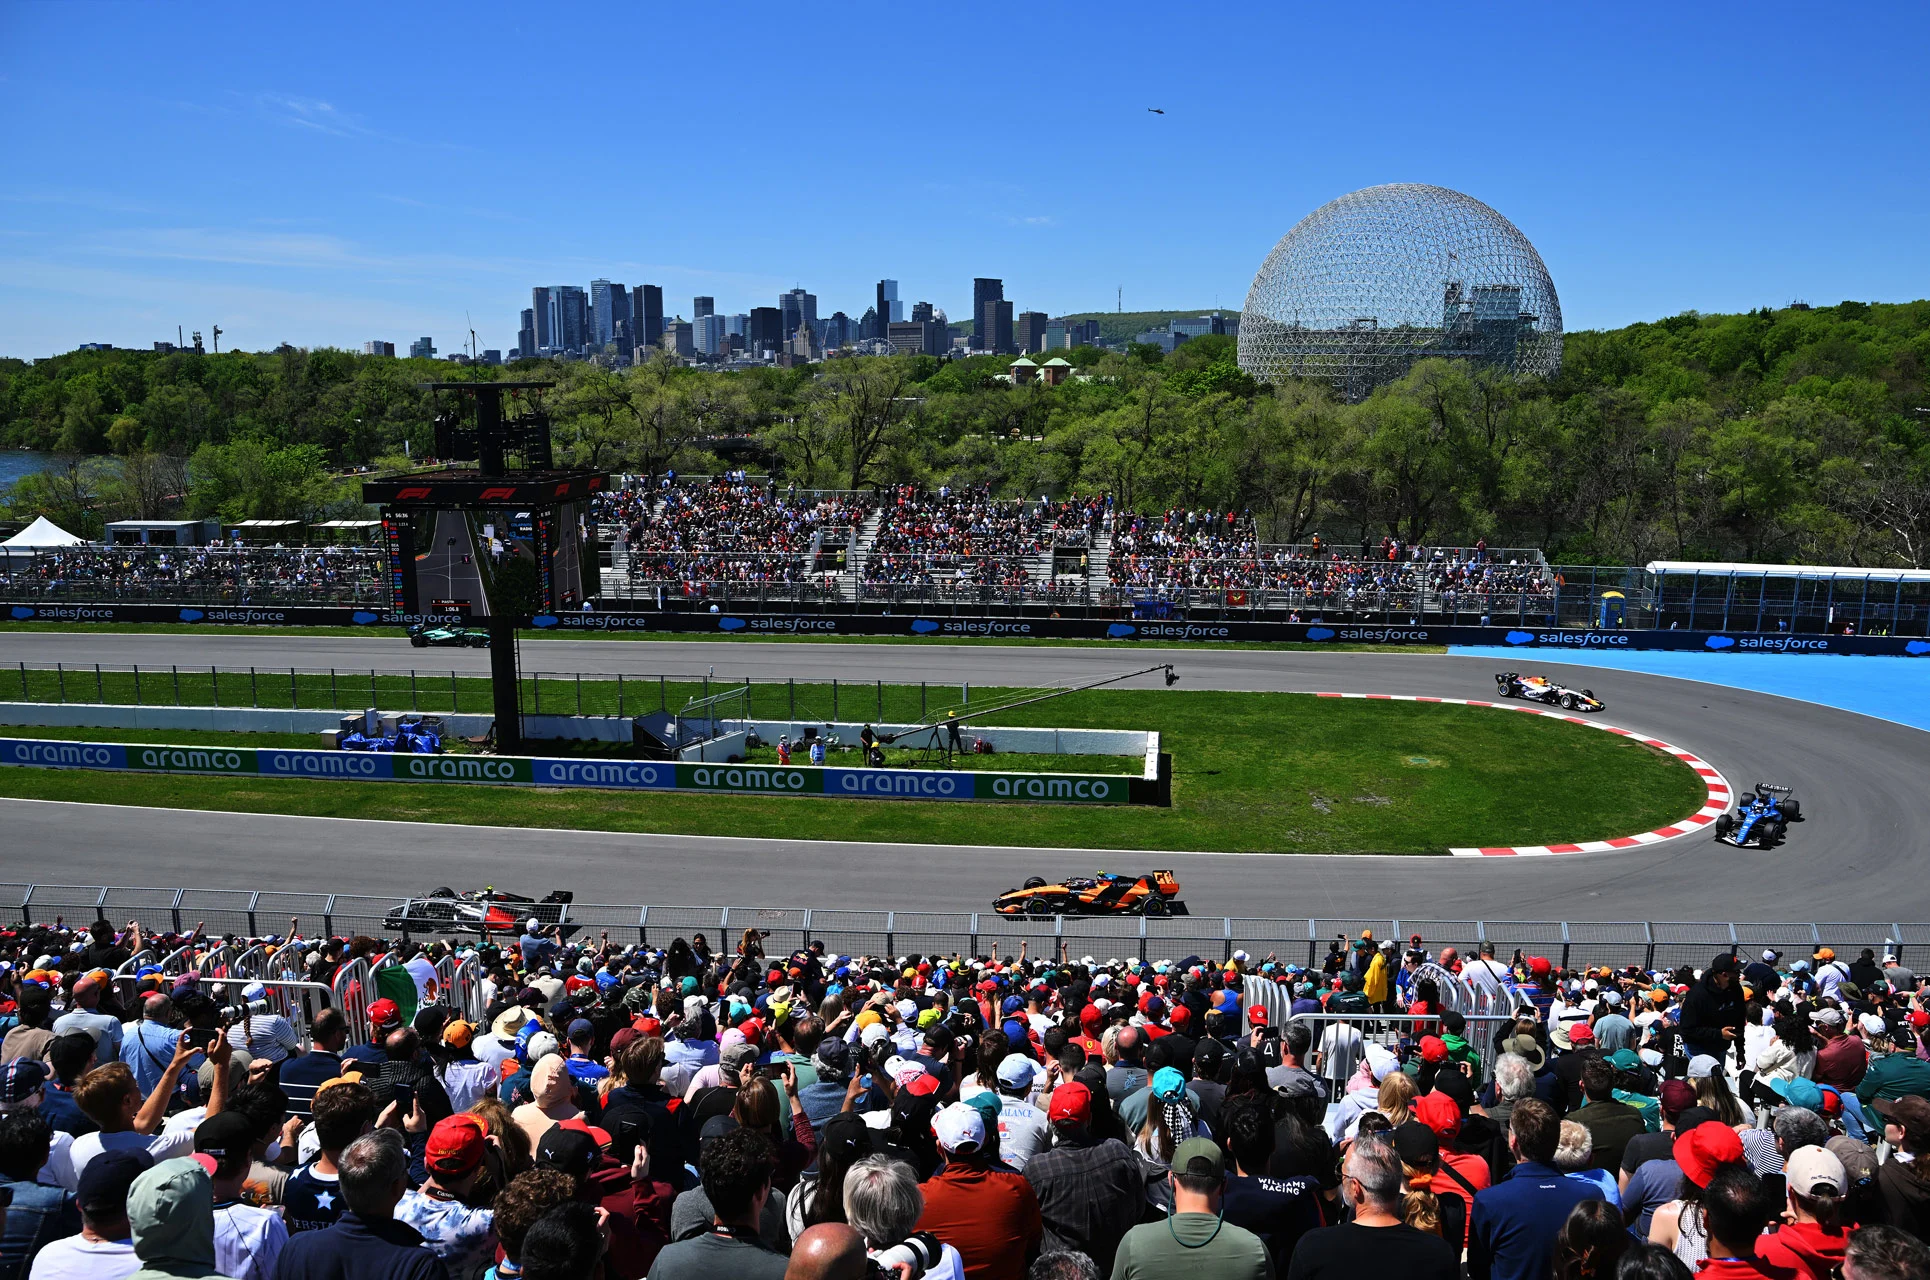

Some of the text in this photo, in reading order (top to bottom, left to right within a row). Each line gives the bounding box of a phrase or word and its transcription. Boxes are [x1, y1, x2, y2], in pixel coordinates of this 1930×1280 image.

[39, 607, 113, 621] salesforce
[208, 609, 284, 623] salesforce
[382, 614, 461, 624] salesforce
[563, 615, 645, 628] salesforce
[750, 617, 836, 631] salesforce
[943, 620, 1031, 634] salesforce
[1140, 623, 1229, 638] salesforce
[1339, 627, 1428, 642] salesforce
[1539, 631, 1628, 647] salesforce
[1739, 636, 1828, 651] salesforce
[15, 744, 111, 765] aramco
[142, 749, 241, 769] aramco
[273, 753, 376, 774] aramco
[409, 759, 515, 779] aramco
[550, 763, 658, 783] aramco
[693, 768, 805, 789] aramco
[841, 773, 955, 794] aramco
[992, 777, 1109, 799] aramco
[1258, 1177, 1306, 1189] WILLIAMS
[1262, 1183, 1300, 1195] RACING
